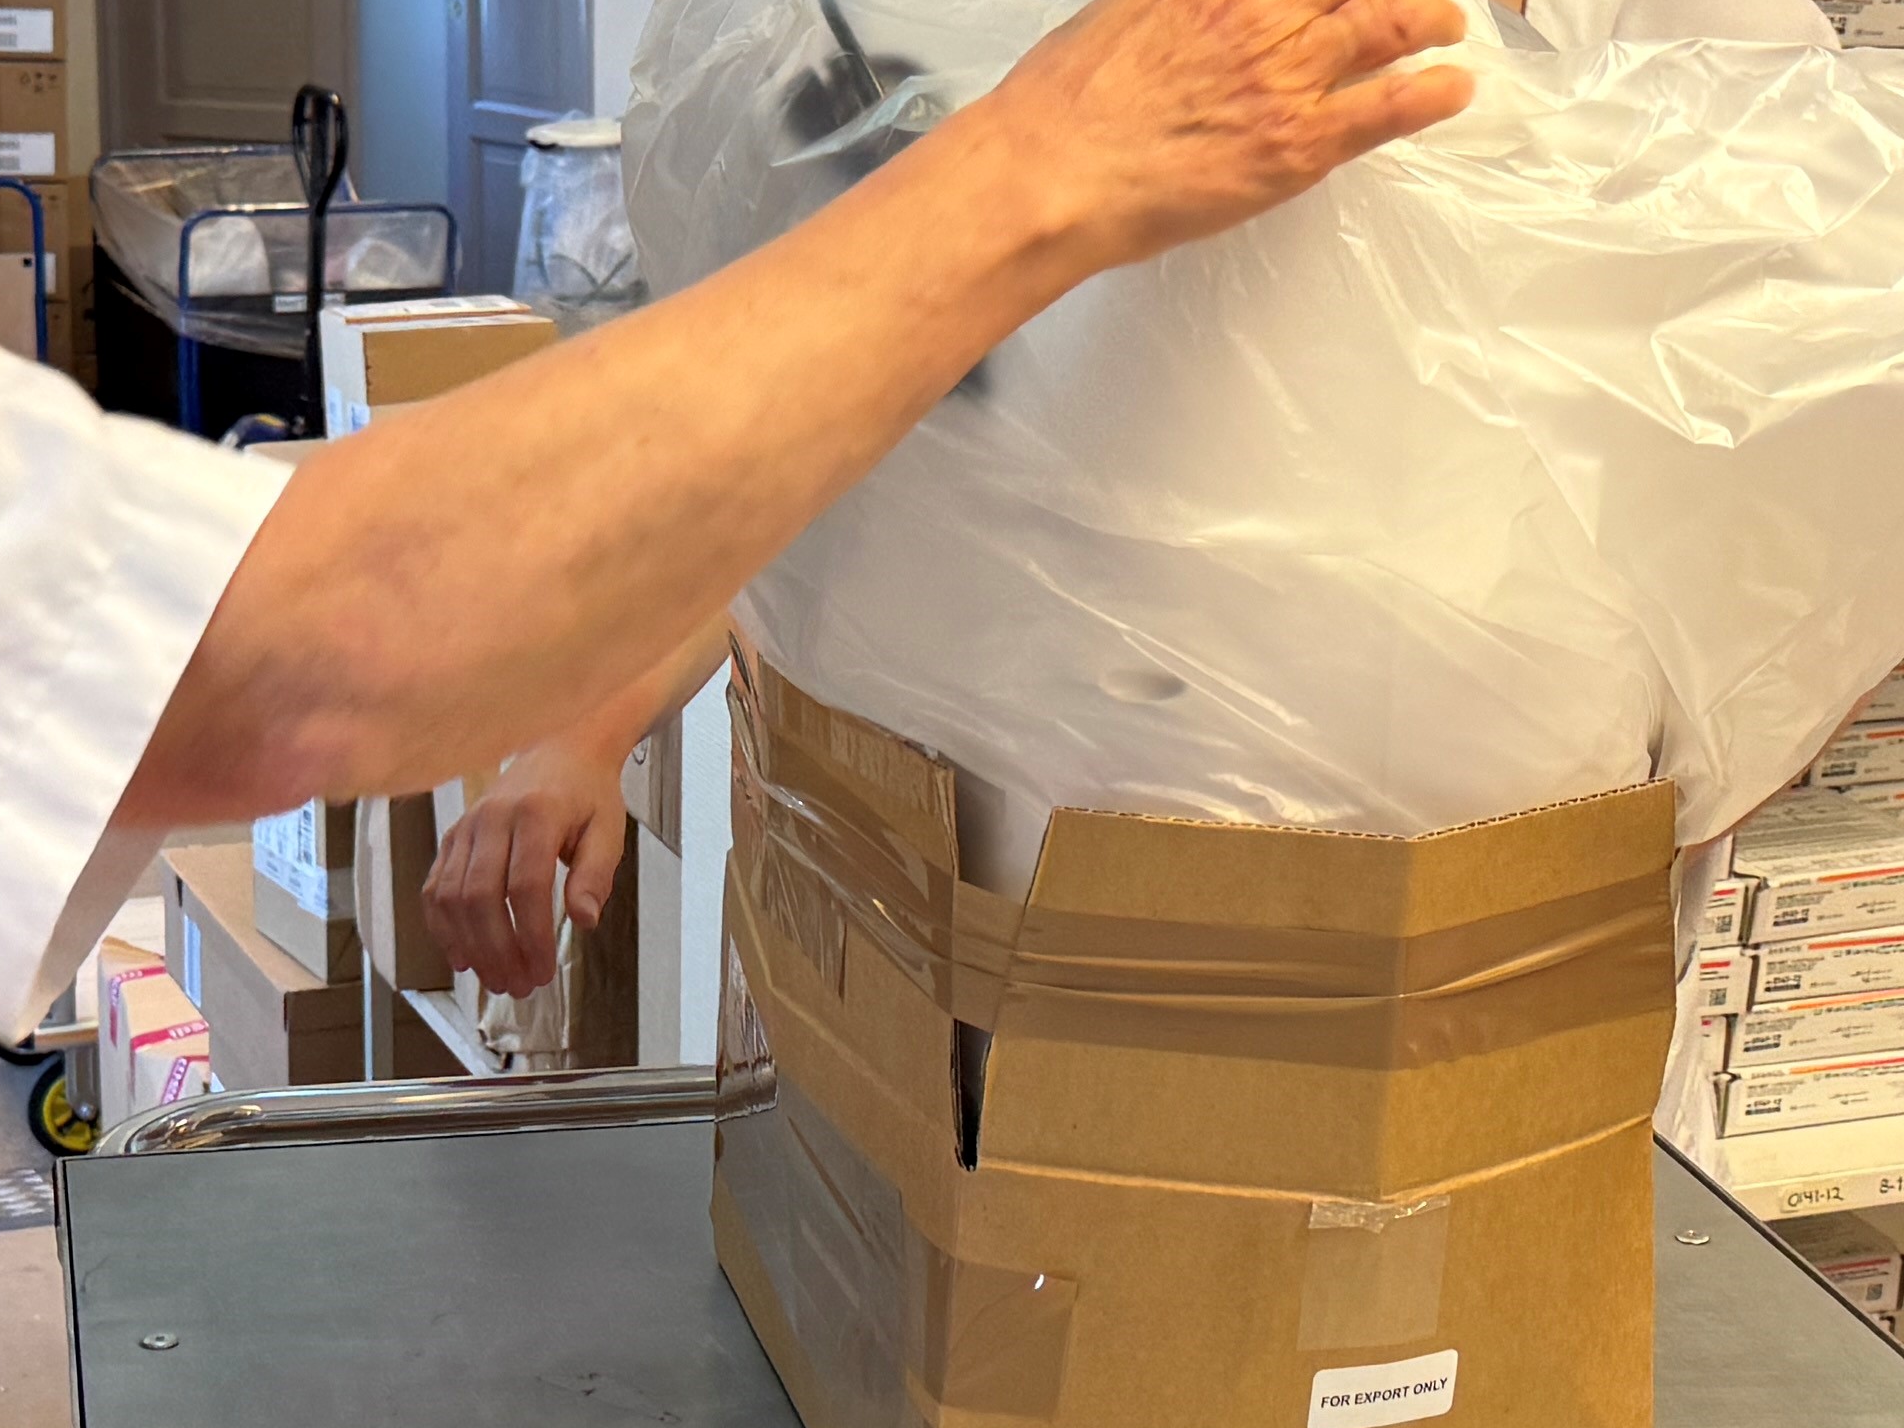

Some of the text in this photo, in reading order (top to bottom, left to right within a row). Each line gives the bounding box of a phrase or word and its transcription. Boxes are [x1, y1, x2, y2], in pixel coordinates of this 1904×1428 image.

[1320, 1376, 1448, 1409] FOR EXPORT ONLY
